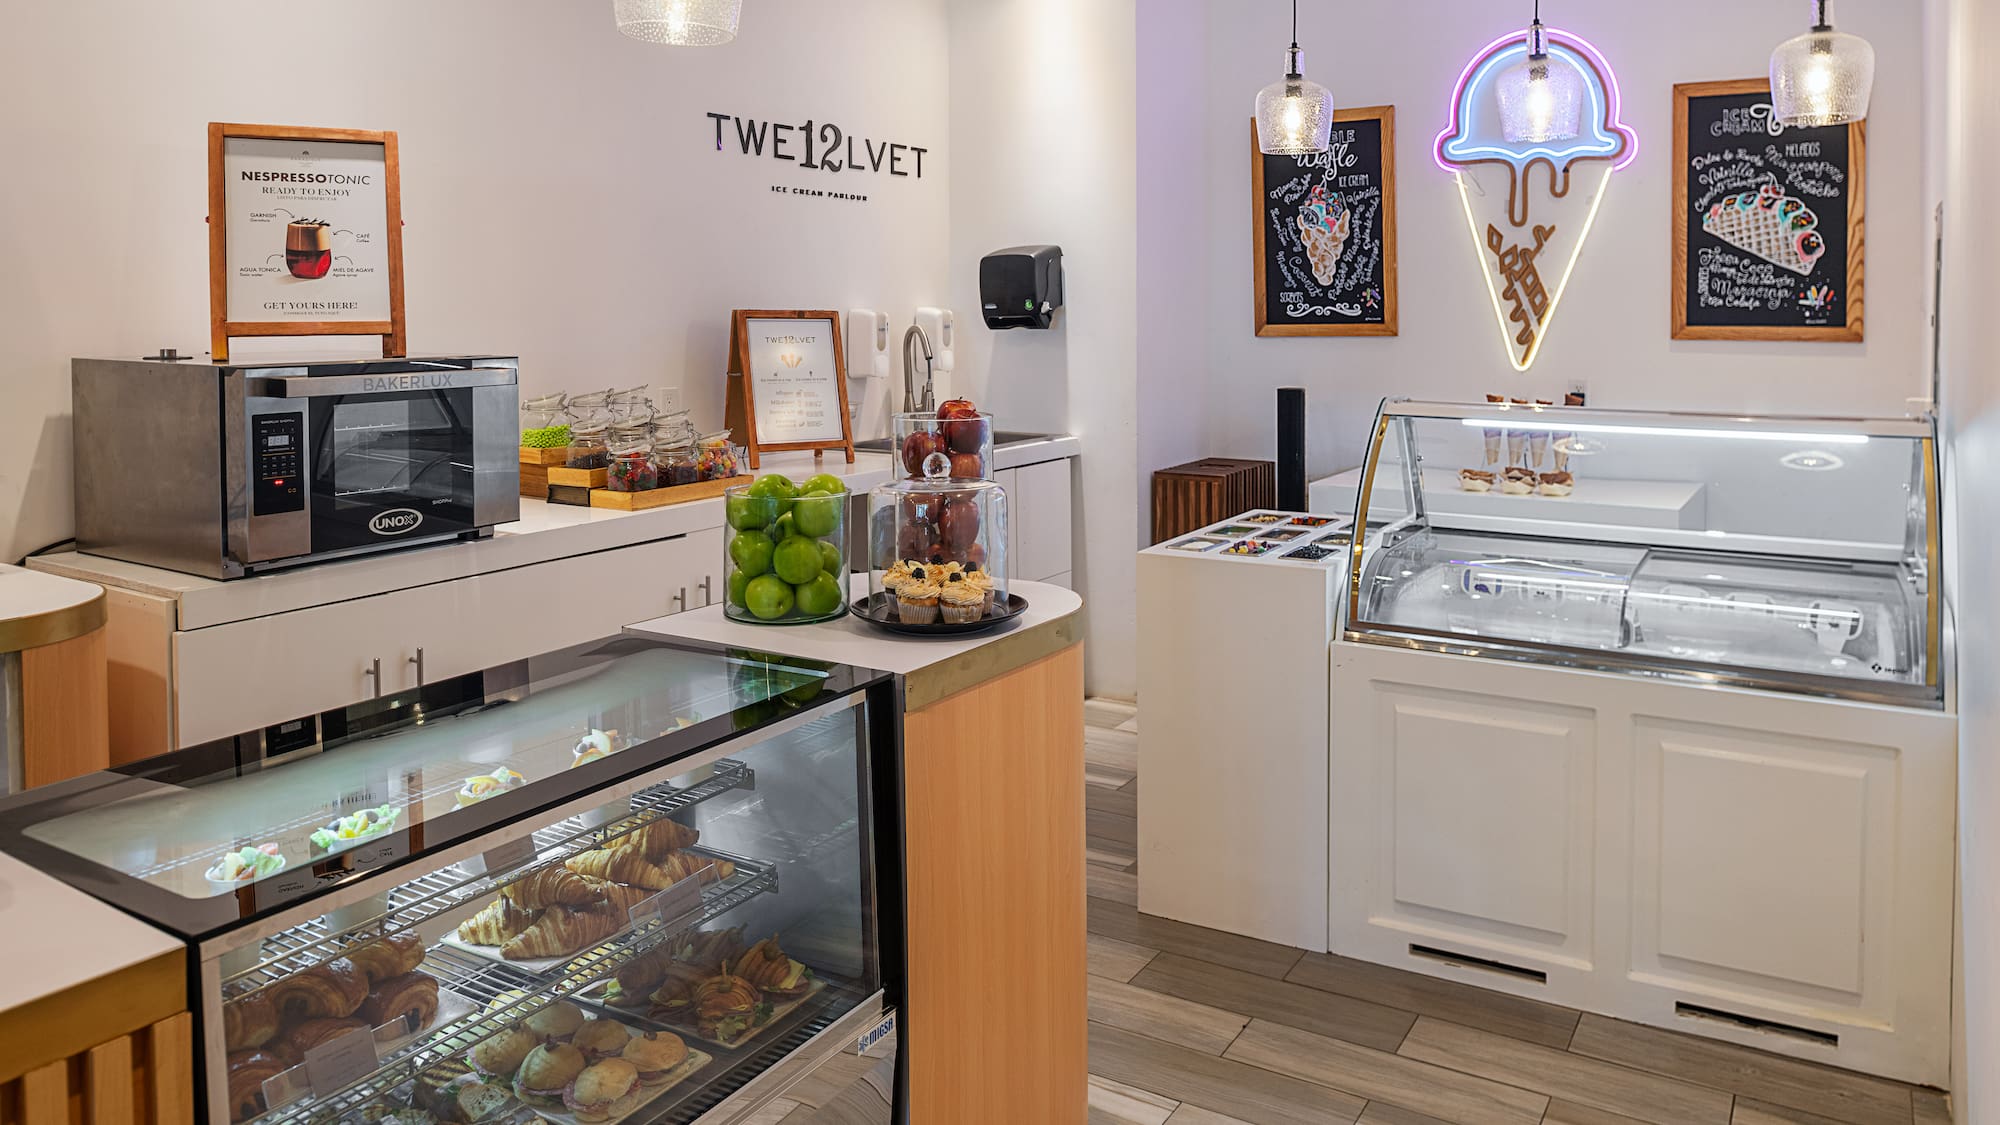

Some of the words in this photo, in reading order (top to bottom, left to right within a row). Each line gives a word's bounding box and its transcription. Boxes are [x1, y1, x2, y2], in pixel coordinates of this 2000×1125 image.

[1722, 108, 1750, 121] ICE
[1710, 119, 1766, 138] CREAM
[241, 170, 371, 186] NESPRESSOTONIC
[262, 186, 297, 195] READY
[299, 187, 316, 196] TO
[318, 188, 351, 197] ENJOY
[771, 185, 788, 193] ICE
[792, 187, 824, 197] CREAM
[827, 191, 868, 202] PARLOUR
[1289, 256, 1324, 297] Coconut
[263, 302, 287, 310] GET
[289, 302, 325, 310] YOURS
[327, 302, 358, 310] HERE!
[363, 373, 454, 392] BAKERLUX
[375, 514, 414, 530] UNOX
